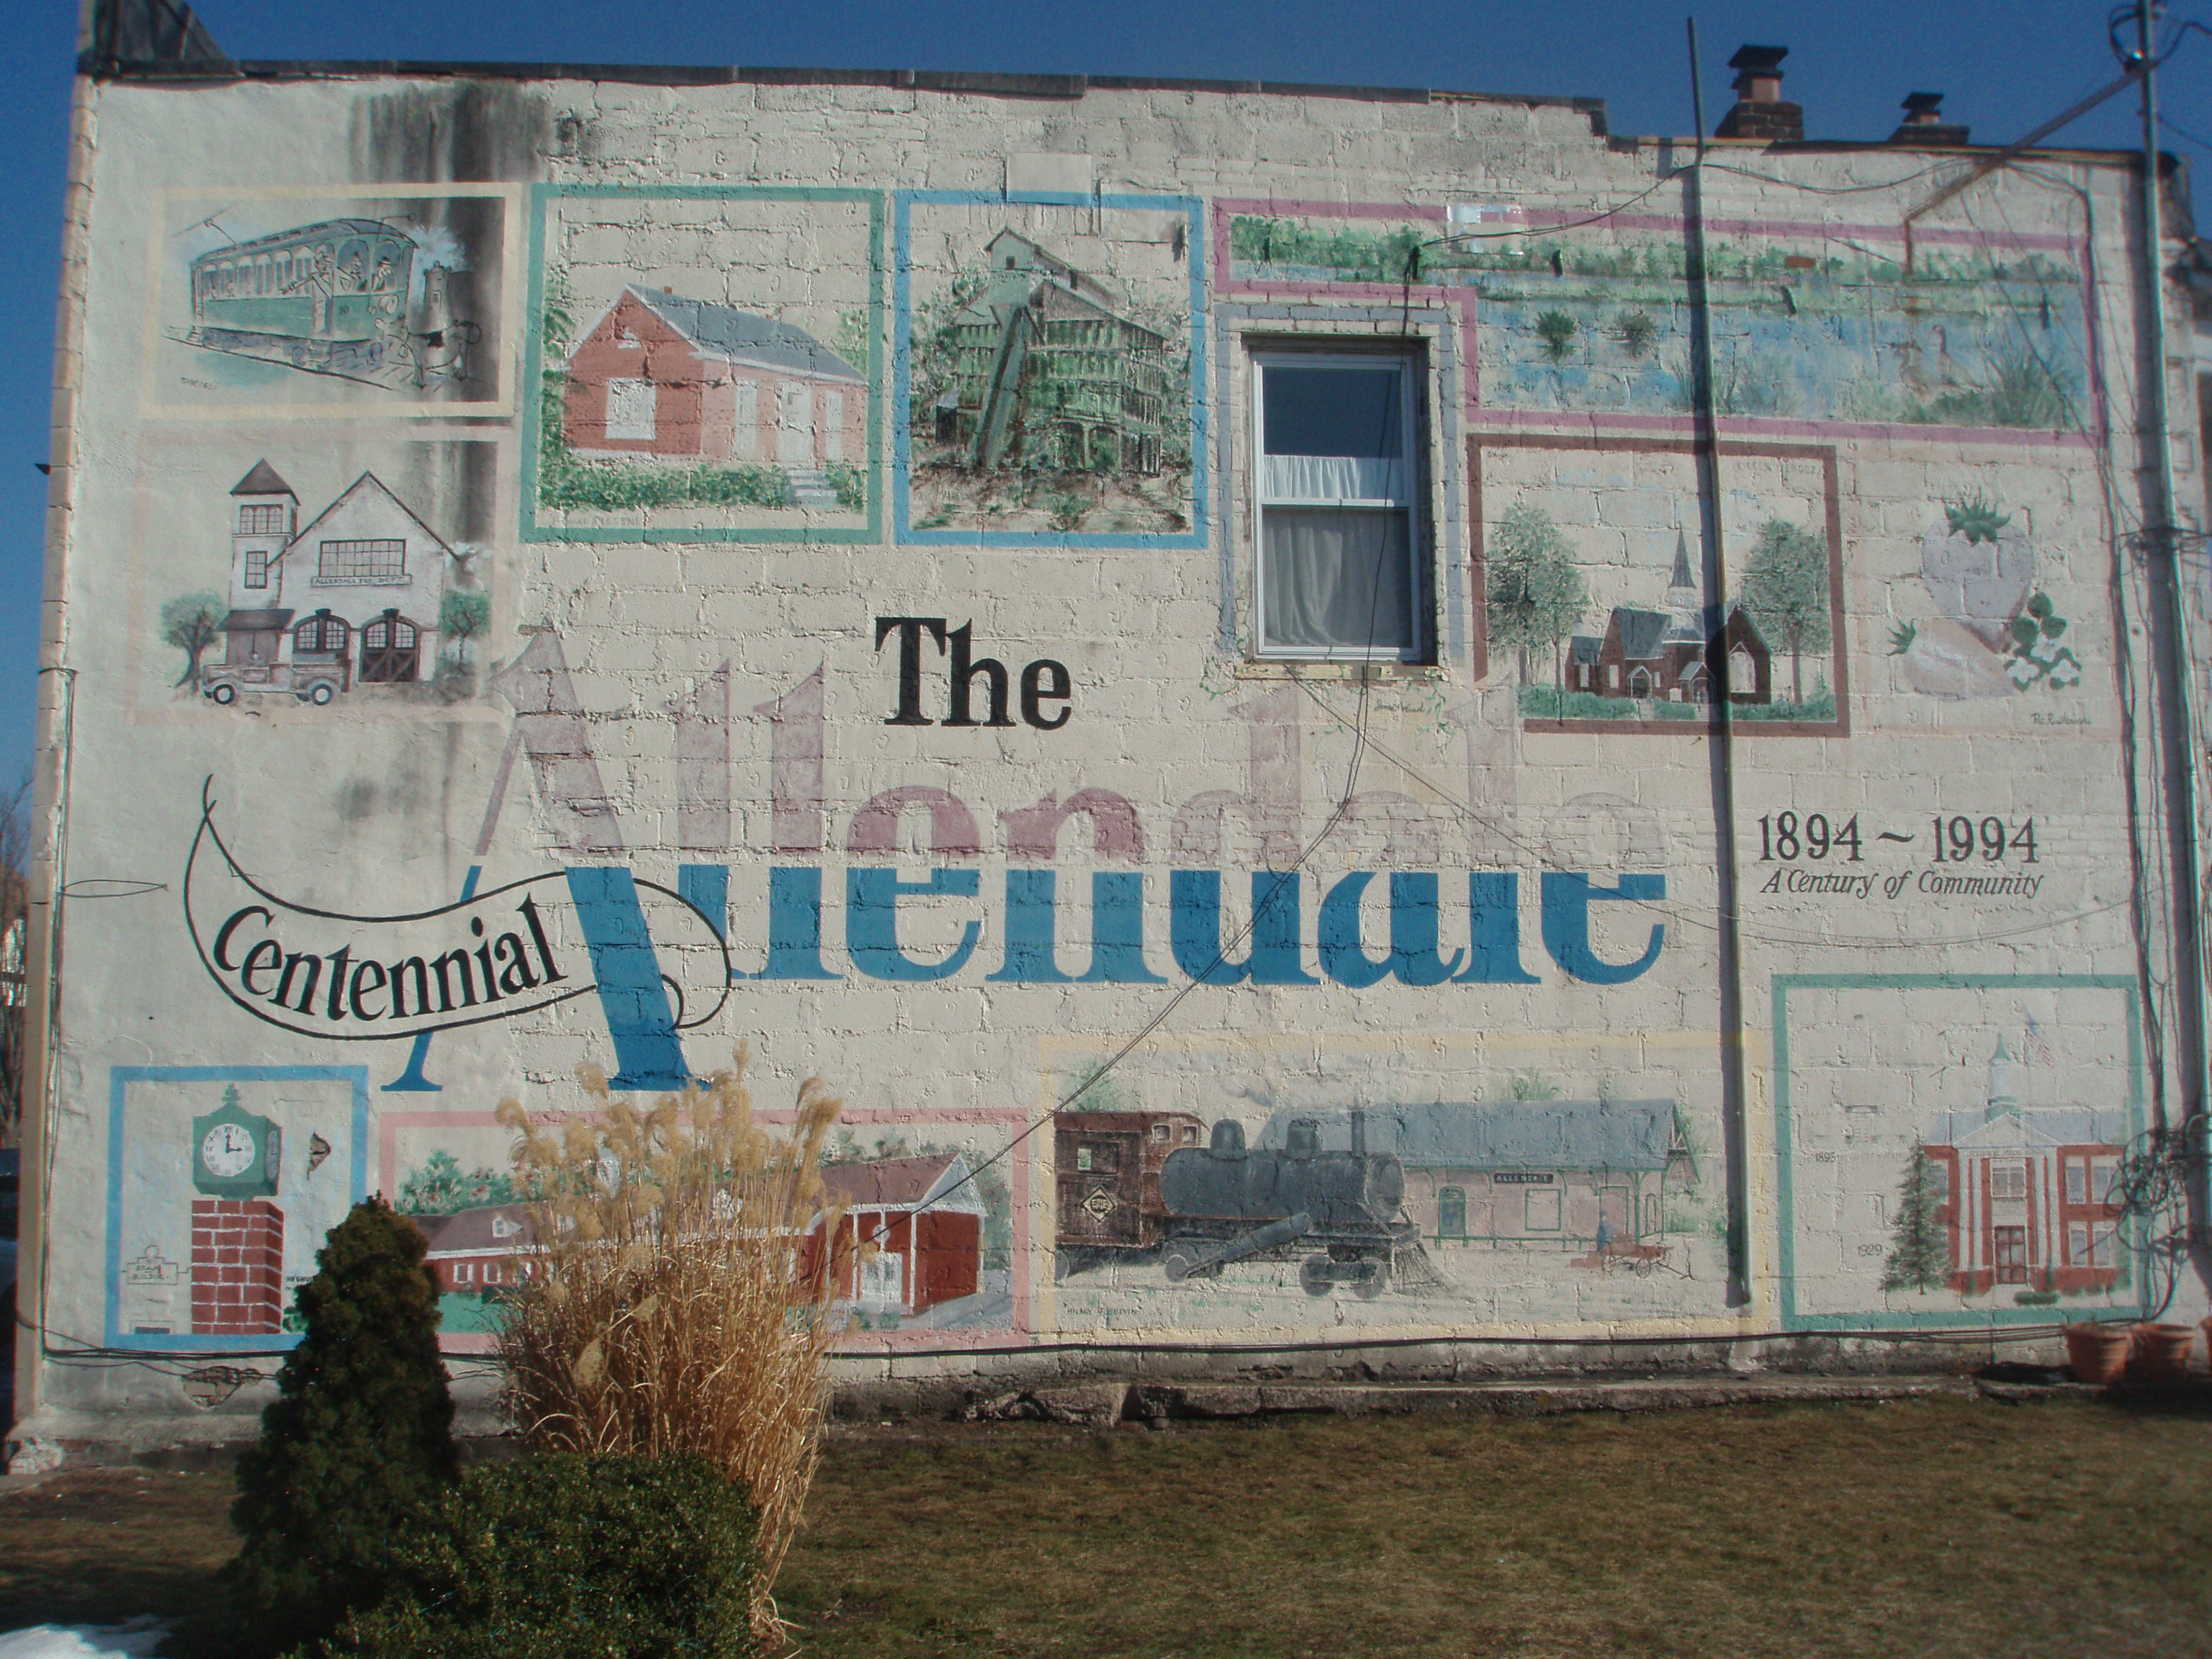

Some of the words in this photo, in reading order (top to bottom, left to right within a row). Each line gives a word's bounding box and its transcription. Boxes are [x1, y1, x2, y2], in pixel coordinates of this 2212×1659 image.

[875, 616, 1072, 729] The
[1758, 811, 1865, 861] 1894
[1931, 815, 2039, 863] 1994
[380, 624, 1668, 1094] Allendale
[1759, 868, 1781, 894] A
[1787, 868, 1879, 899] Century
[1884, 870, 1912, 899] of
[1917, 870, 2044, 899] Community
[213, 891, 568, 1021] Centennial
[1815, 1152, 1836, 1163] 1895
[1090, 1198, 1109, 1210] ERIE
[1858, 1244, 1882, 1256] 1929
